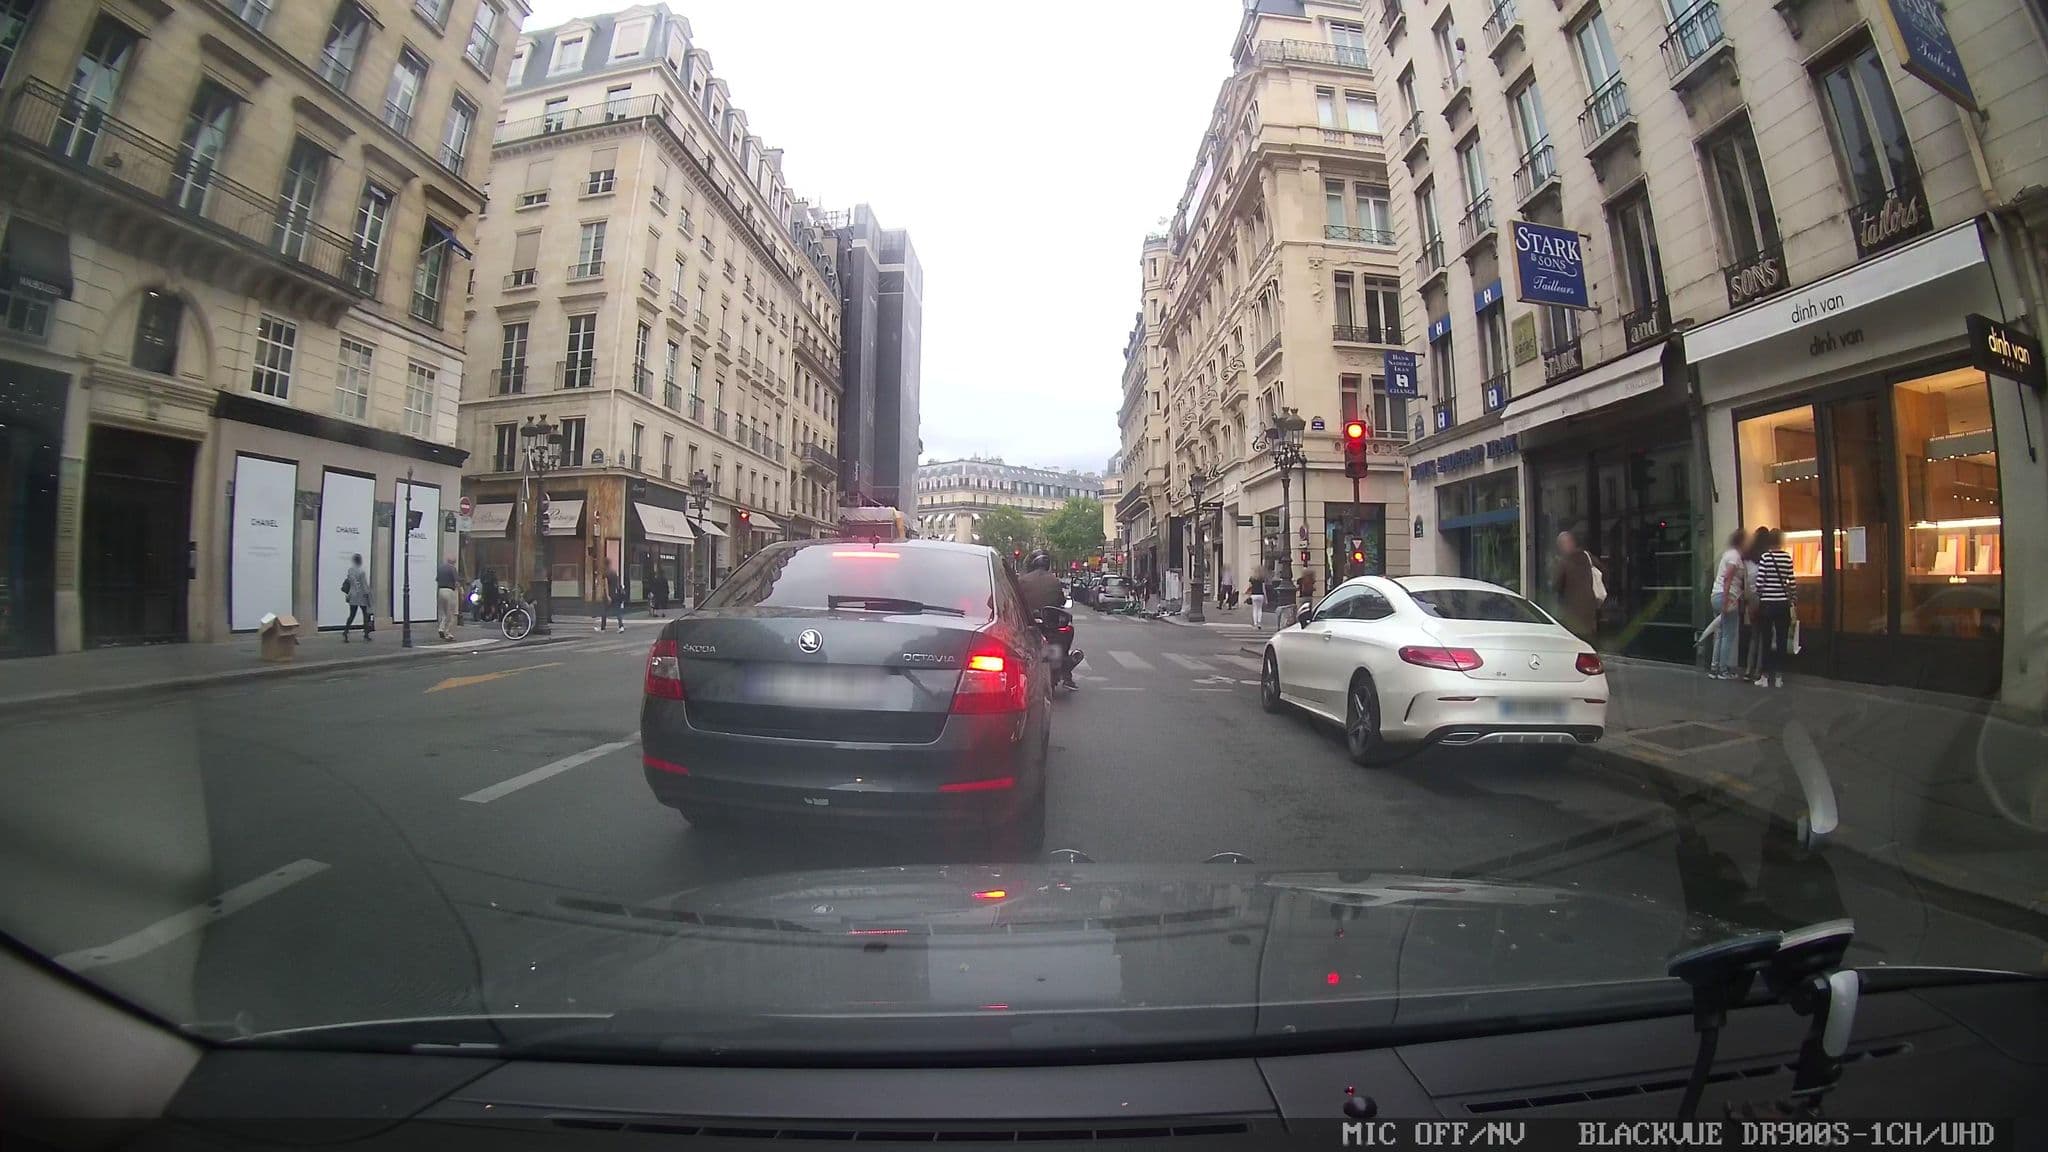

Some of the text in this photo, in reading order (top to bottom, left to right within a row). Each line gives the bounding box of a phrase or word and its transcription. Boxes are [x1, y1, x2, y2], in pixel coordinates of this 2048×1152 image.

[1860, 195, 1920, 248] tailors
[1516, 226, 1582, 265] STARK
[1538, 255, 1567, 271] SONS
[1533, 275, 1575, 294] Tailleurs
[1791, 294, 1845, 323] dinh van
[1630, 314, 1661, 343] and
[1808, 327, 1865, 357] dinh van
[1988, 325, 2011, 357] dinh
[2011, 343, 2031, 366] van
[251, 518, 279, 528] CHANEL
[336, 526, 360, 535] CHANEL
[903, 653, 956, 663] OCTAVIA
